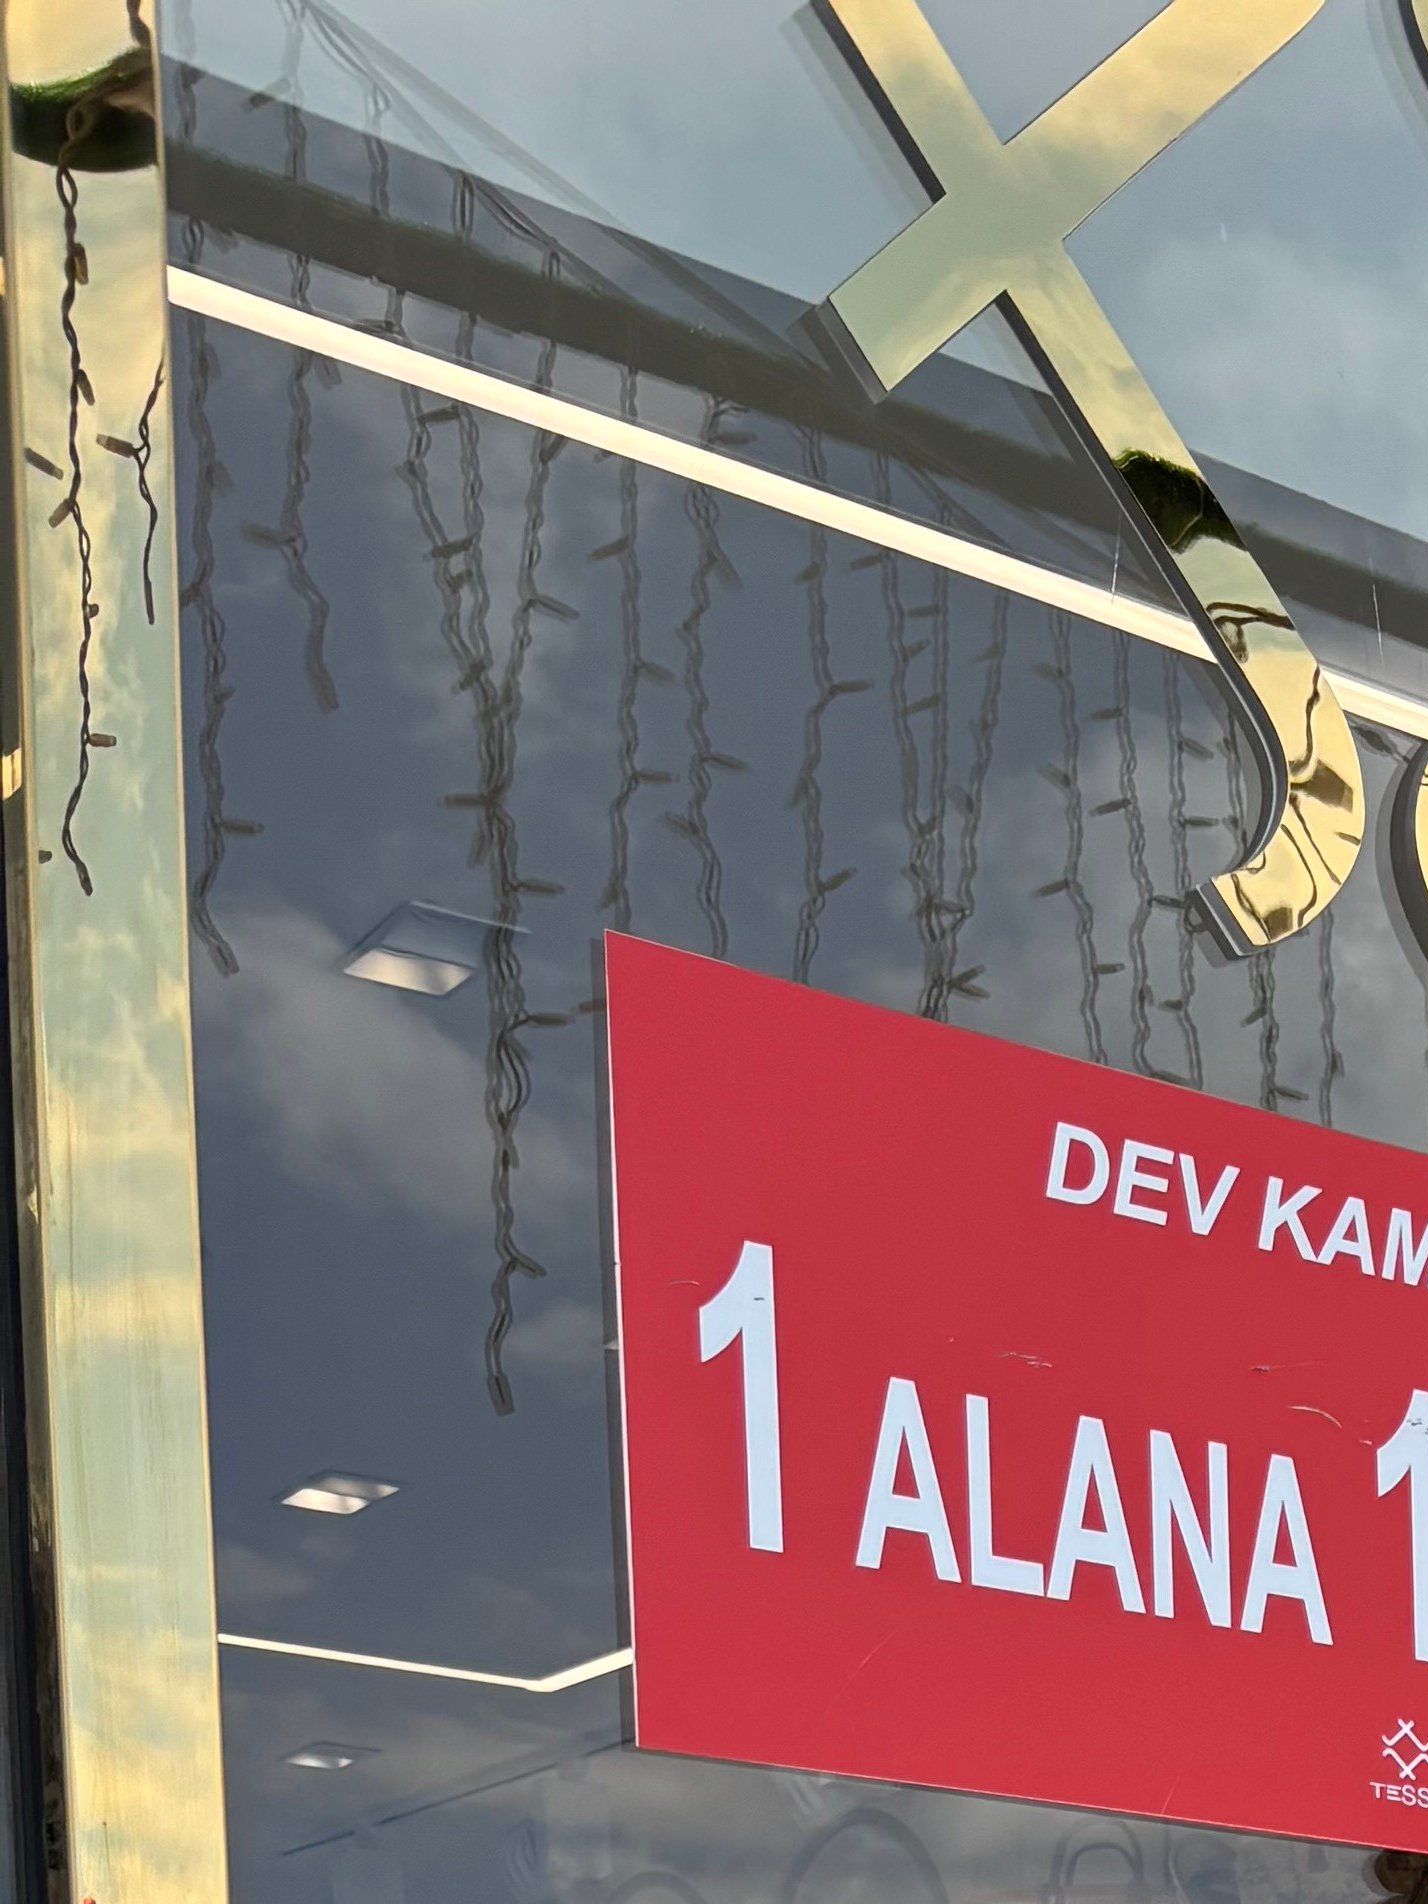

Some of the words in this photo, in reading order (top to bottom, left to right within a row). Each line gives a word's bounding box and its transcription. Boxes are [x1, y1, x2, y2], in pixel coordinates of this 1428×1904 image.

[1046, 1122, 1240, 1235] DEV
[699, 1241, 783, 1552] 1
[856, 1377, 1333, 1645] ALANA
